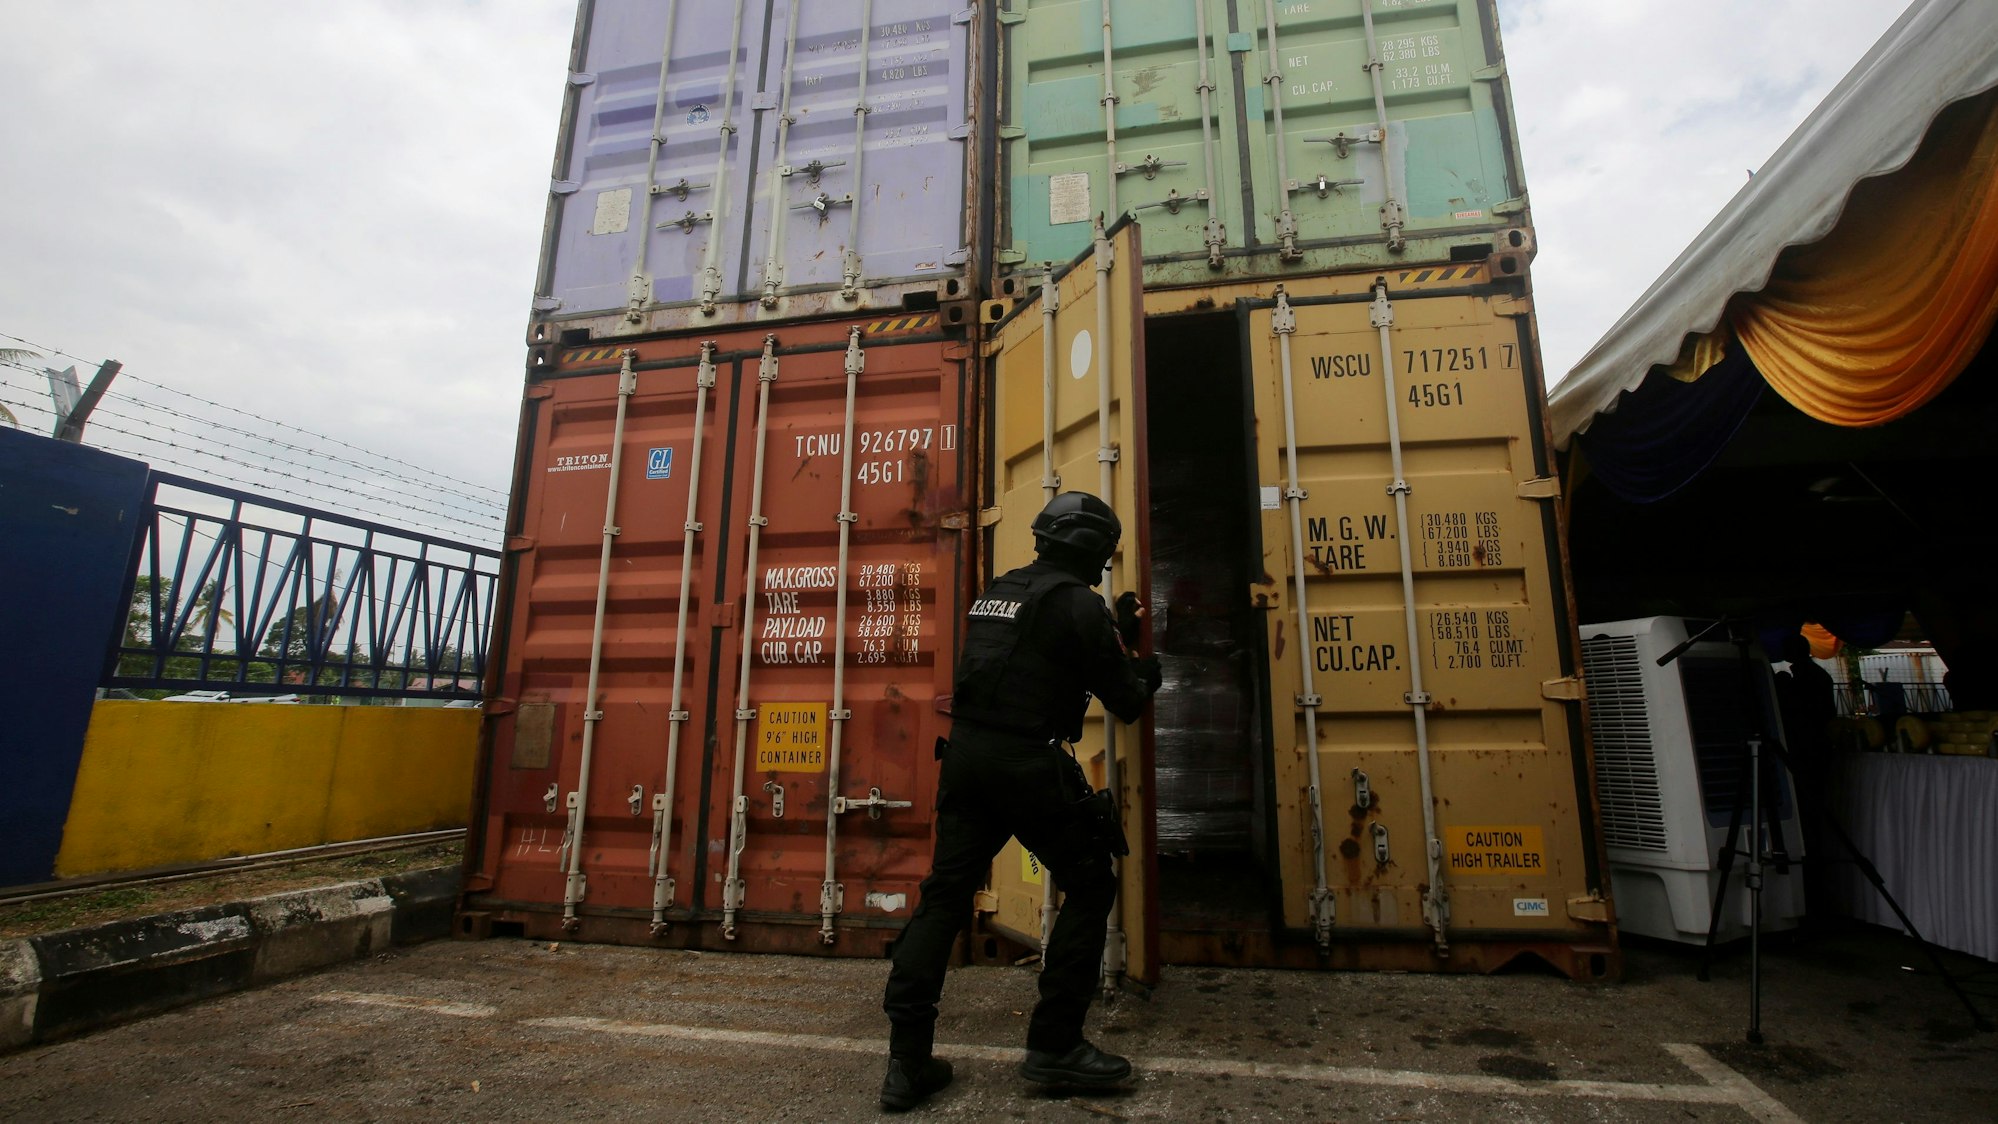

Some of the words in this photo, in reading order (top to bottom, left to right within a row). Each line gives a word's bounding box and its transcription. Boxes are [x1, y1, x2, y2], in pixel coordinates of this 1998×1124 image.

[1420, 35, 1439, 47] KGS
[1383, 49, 1417, 62] 62.380
[1422, 46, 1440, 58] LBS
[1288, 56, 1309, 68] NET
[913, 65, 928, 77] LBS
[1395, 66, 1418, 79] 33.2
[1292, 81, 1338, 96] CU.CAP.
[1311, 353, 1371, 379] WSCU
[1403, 346, 1488, 373] 717251
[1408, 382, 1463, 408] 45G1
[796, 433, 841, 458] TCNU
[860, 429, 933, 454] 926797
[557, 453, 608, 466] TRITON
[650, 450, 670, 470] GL
[547, 462, 612, 473] www.tritoncontainer.co
[858, 460, 903, 484] 45G1
[1427, 513, 1466, 527] 30.480
[1475, 512, 1497, 525] KGS
[1429, 526, 1468, 540] 67.200
[1477, 525, 1499, 538] LBS
[1437, 541, 1469, 554] 3.940
[1310, 545, 1366, 570] TARE
[1438, 554, 1470, 568] 8.690
[901, 574, 920, 586] LBS
[765, 592, 800, 614] TARE
[903, 600, 922, 612] LBS
[968, 600, 1022, 618] KASTAM
[902, 614, 921, 626] KGS
[1436, 612, 1477, 626] 26.540
[1487, 611, 1509, 625] KGS
[763, 617, 826, 638] PAYLOAD
[1314, 616, 1354, 642] NET
[1438, 626, 1478, 640] 58.510
[1488, 625, 1510, 638] LBS
[794, 641, 825, 664] CAP.
[863, 639, 885, 651] 76.3
[1455, 641, 1480, 655] 76.4
[858, 652, 887, 664] 2.695
[1316, 645, 1400, 672] CU.CAP.
[1448, 655, 1481, 669] 2.700
[770, 711, 816, 724] CAUTION
[792, 731, 817, 743] HIGH
[760, 751, 822, 764] CONTAINER
[1466, 831, 1523, 847] CAUTION
[1452, 853, 1482, 868] HIGH
[1485, 853, 1541, 868] TRAILER
[1516, 902, 1546, 911] CIMC
